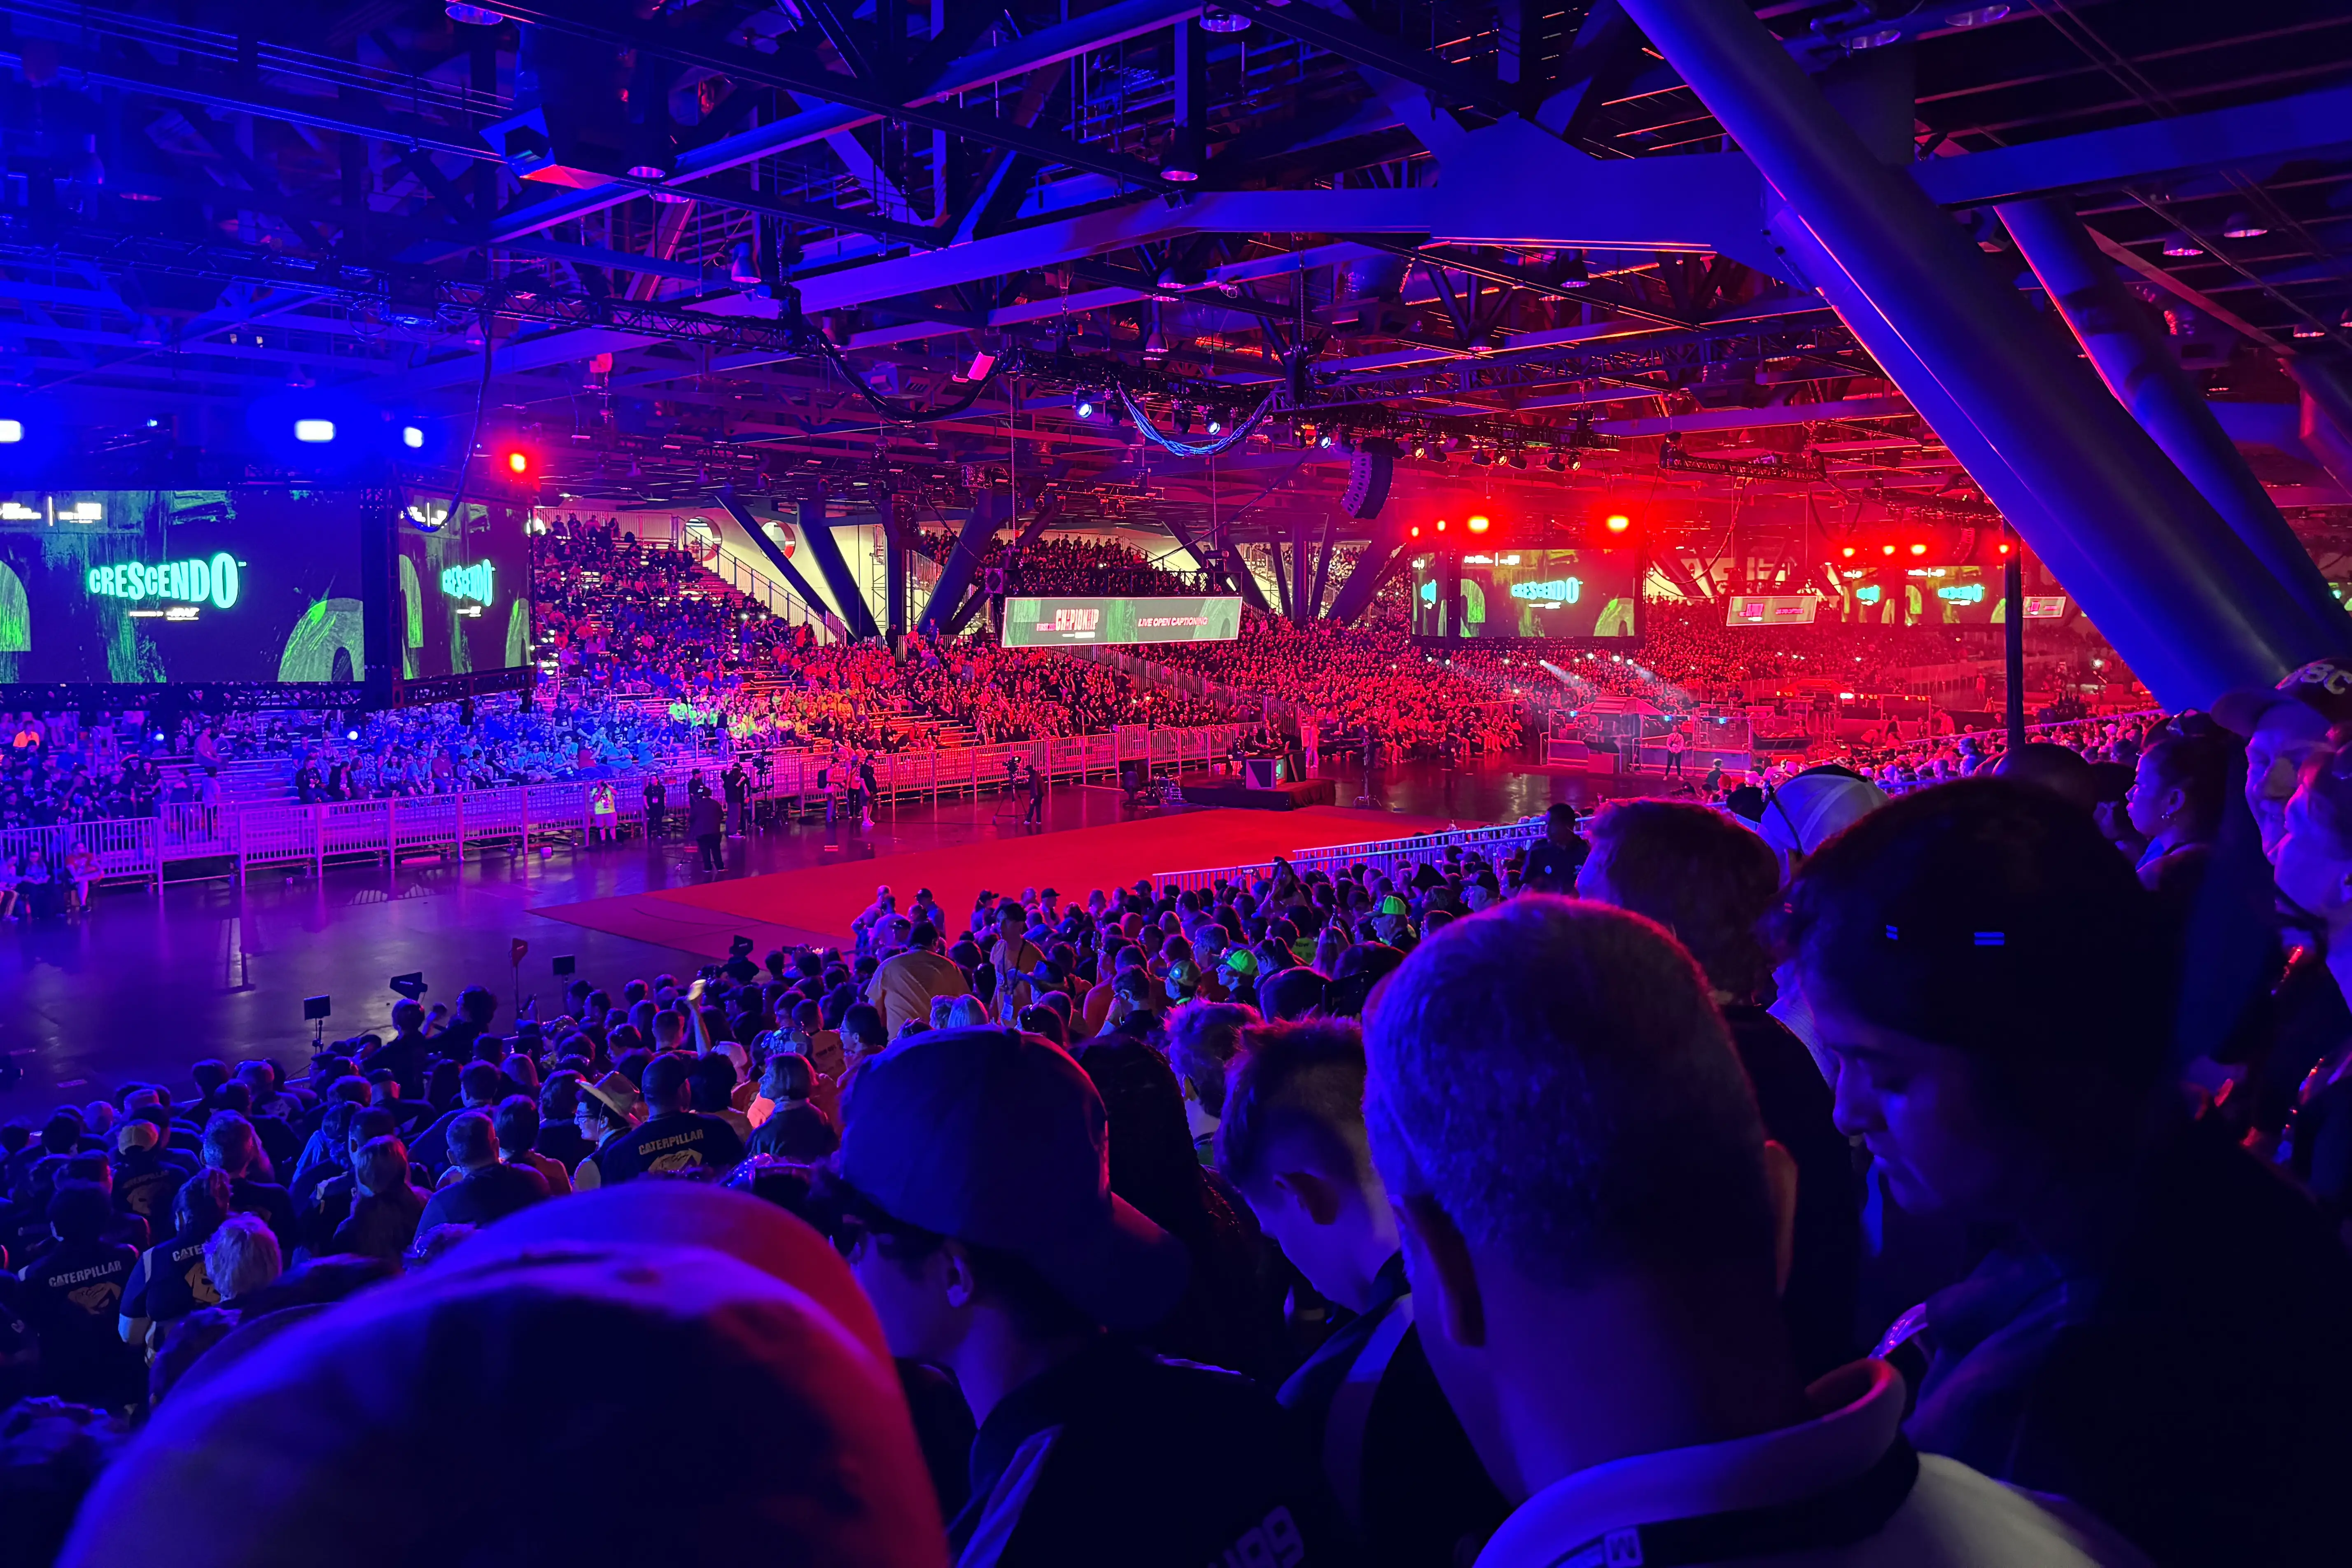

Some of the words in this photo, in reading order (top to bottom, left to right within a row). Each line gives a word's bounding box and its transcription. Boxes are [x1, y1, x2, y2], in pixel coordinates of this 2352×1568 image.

[89, 553, 239, 608] CRESCENDO
[1138, 618, 1153, 627] LIVE
[1153, 617, 1171, 627] OPEN
[1171, 617, 1209, 626] CAPTIONING
[639, 1129, 704, 1155] CATERPILLAR
[49, 1260, 122, 1287] CATERPILLAR
